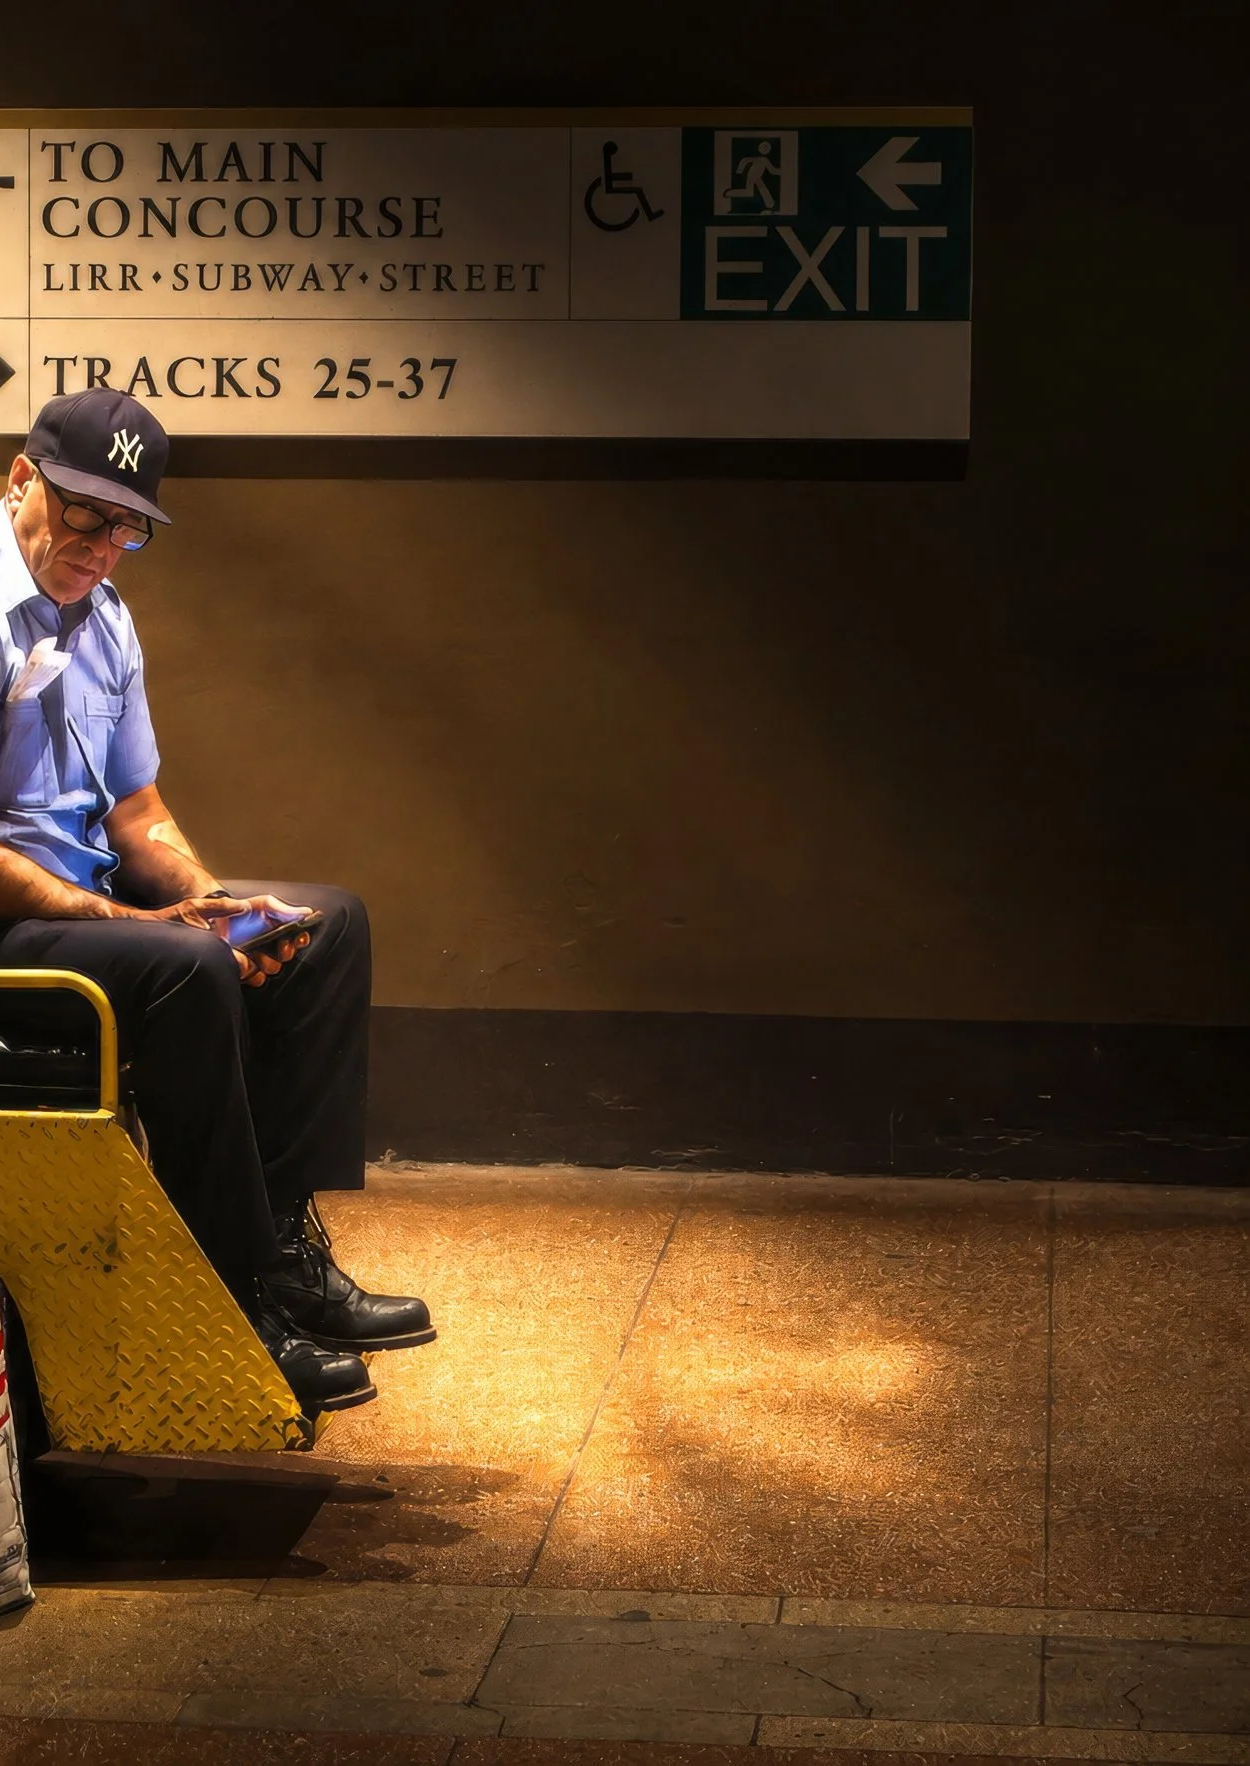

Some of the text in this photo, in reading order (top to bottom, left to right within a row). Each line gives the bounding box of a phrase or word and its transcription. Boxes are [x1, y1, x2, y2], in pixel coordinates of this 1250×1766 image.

[41, 141, 329, 183] TO MAIN
[41, 196, 444, 239] CONCOURSE
[42, 263, 546, 292] LIRR SUBWAY STREET
[704, 226, 948, 311] EXIT
[43, 356, 458, 400] TRACKS 25-37
[107, 428, 144, 473] NY
